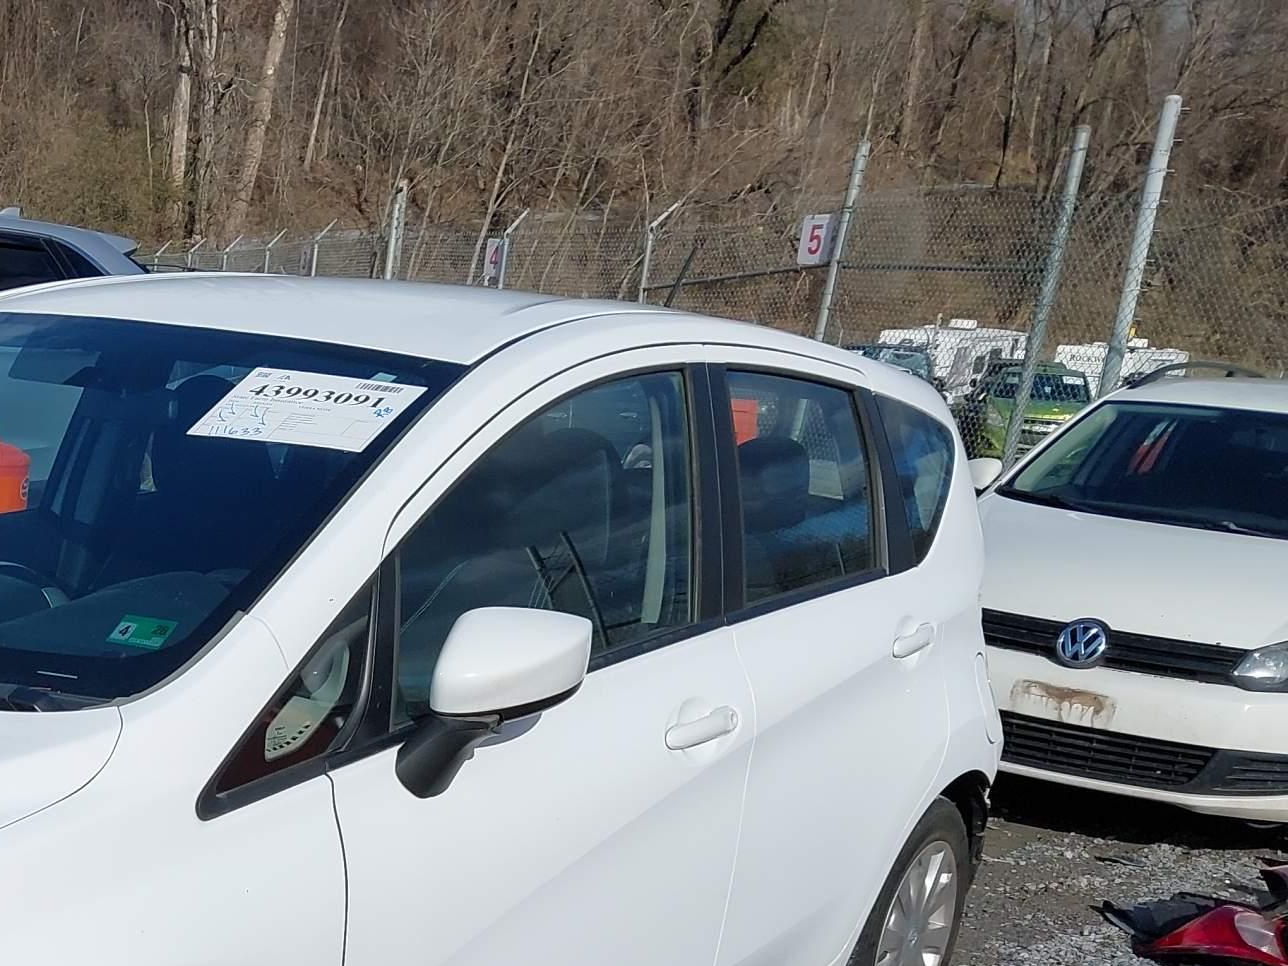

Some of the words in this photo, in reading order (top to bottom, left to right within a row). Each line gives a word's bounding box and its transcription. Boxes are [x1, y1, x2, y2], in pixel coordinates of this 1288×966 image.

[806, 223, 824, 255] 5
[489, 246, 498, 269] 4
[249, 383, 387, 408] 43993091
[119, 624, 131, 637] 4
